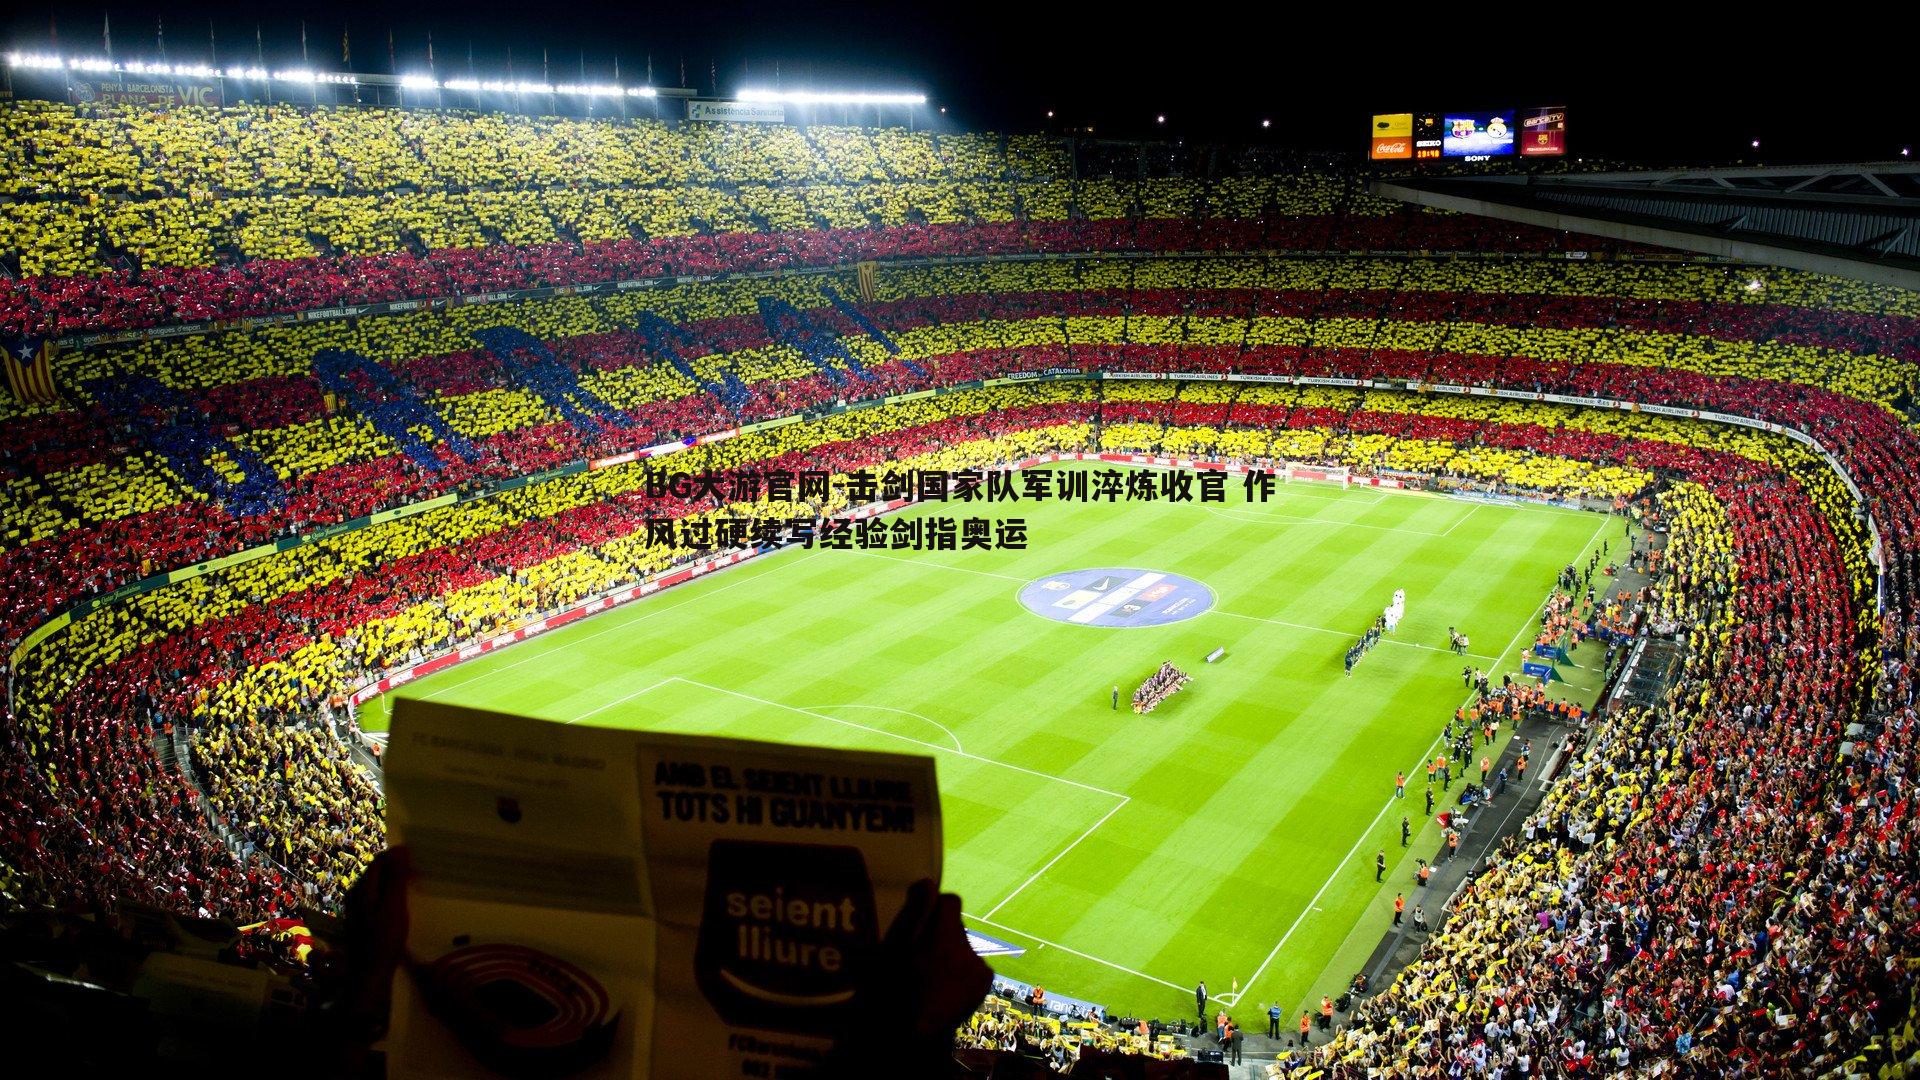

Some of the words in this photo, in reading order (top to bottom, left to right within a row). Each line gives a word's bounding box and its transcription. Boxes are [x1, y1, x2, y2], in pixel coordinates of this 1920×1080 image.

[176, 85, 215, 106] VIC
[307, 308, 358, 320] NIKEFOOTBALL.COM
[1007, 371, 1038, 380] FREEDOM
[1043, 367, 1081, 376] CATALONIA
[1558, 396, 1583, 404] TURKISH
[1661, 406, 1689, 416] AIRLINES
[1714, 413, 1739, 423] TURKISH
[1739, 417, 1763, 428] AIRLINES
[655, 761, 706, 788] AMB
[711, 765, 740, 790] EL
[743, 768, 822, 797] SEIENT
[828, 775, 911, 802] LLIURE
[657, 791, 730, 824] TOTS
[736, 795, 763, 826] HI
[727, 886, 855, 931] seient
[738, 925, 842, 972] lliure
